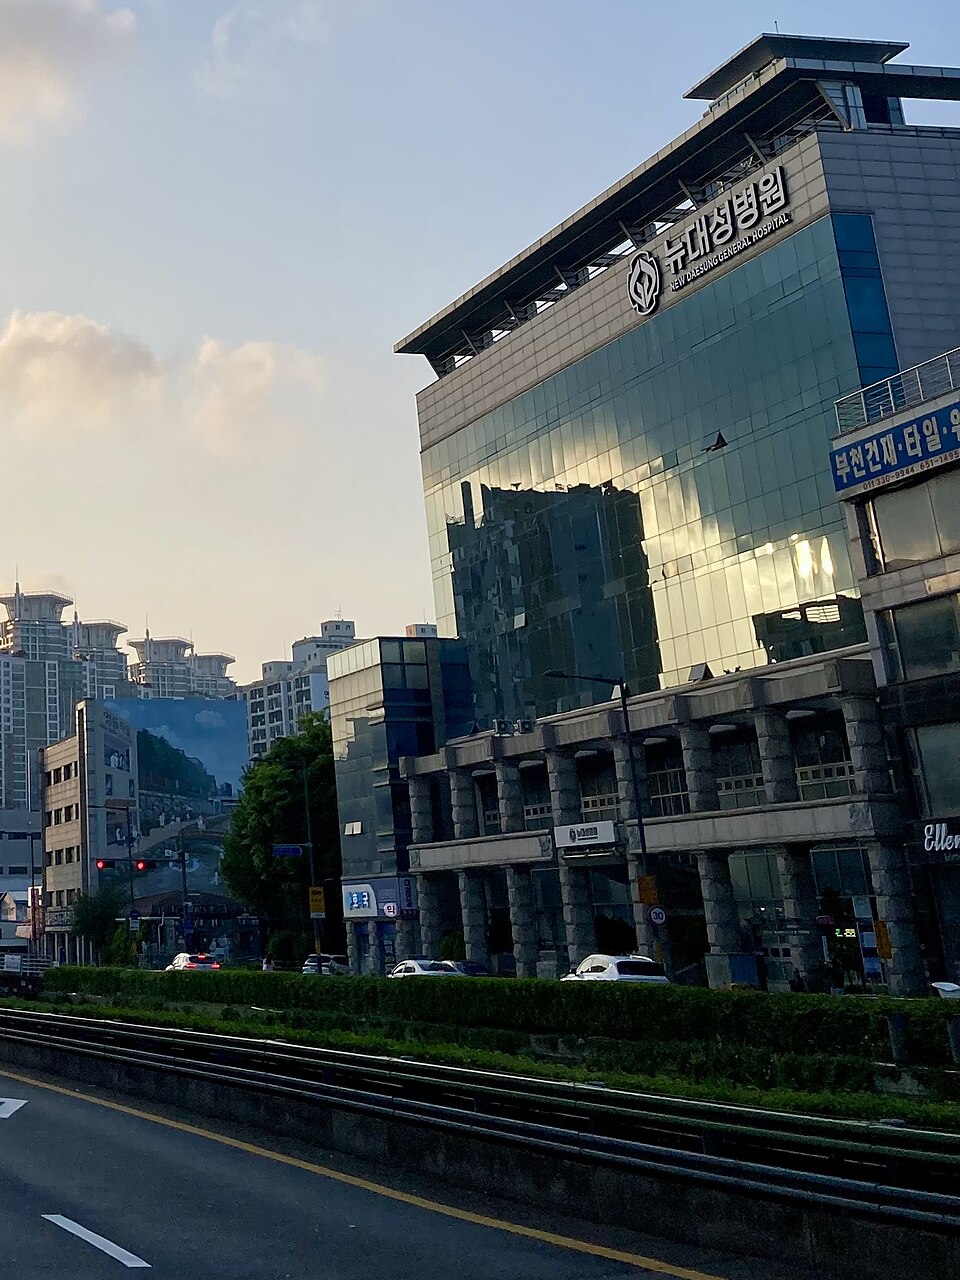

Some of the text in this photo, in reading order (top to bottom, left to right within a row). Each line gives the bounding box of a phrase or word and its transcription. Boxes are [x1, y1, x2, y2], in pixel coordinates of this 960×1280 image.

[664, 166, 787, 274] 뉴대성병원
[670, 214, 789, 291] NEW DAESUNG GENERAL HOSPITAL
